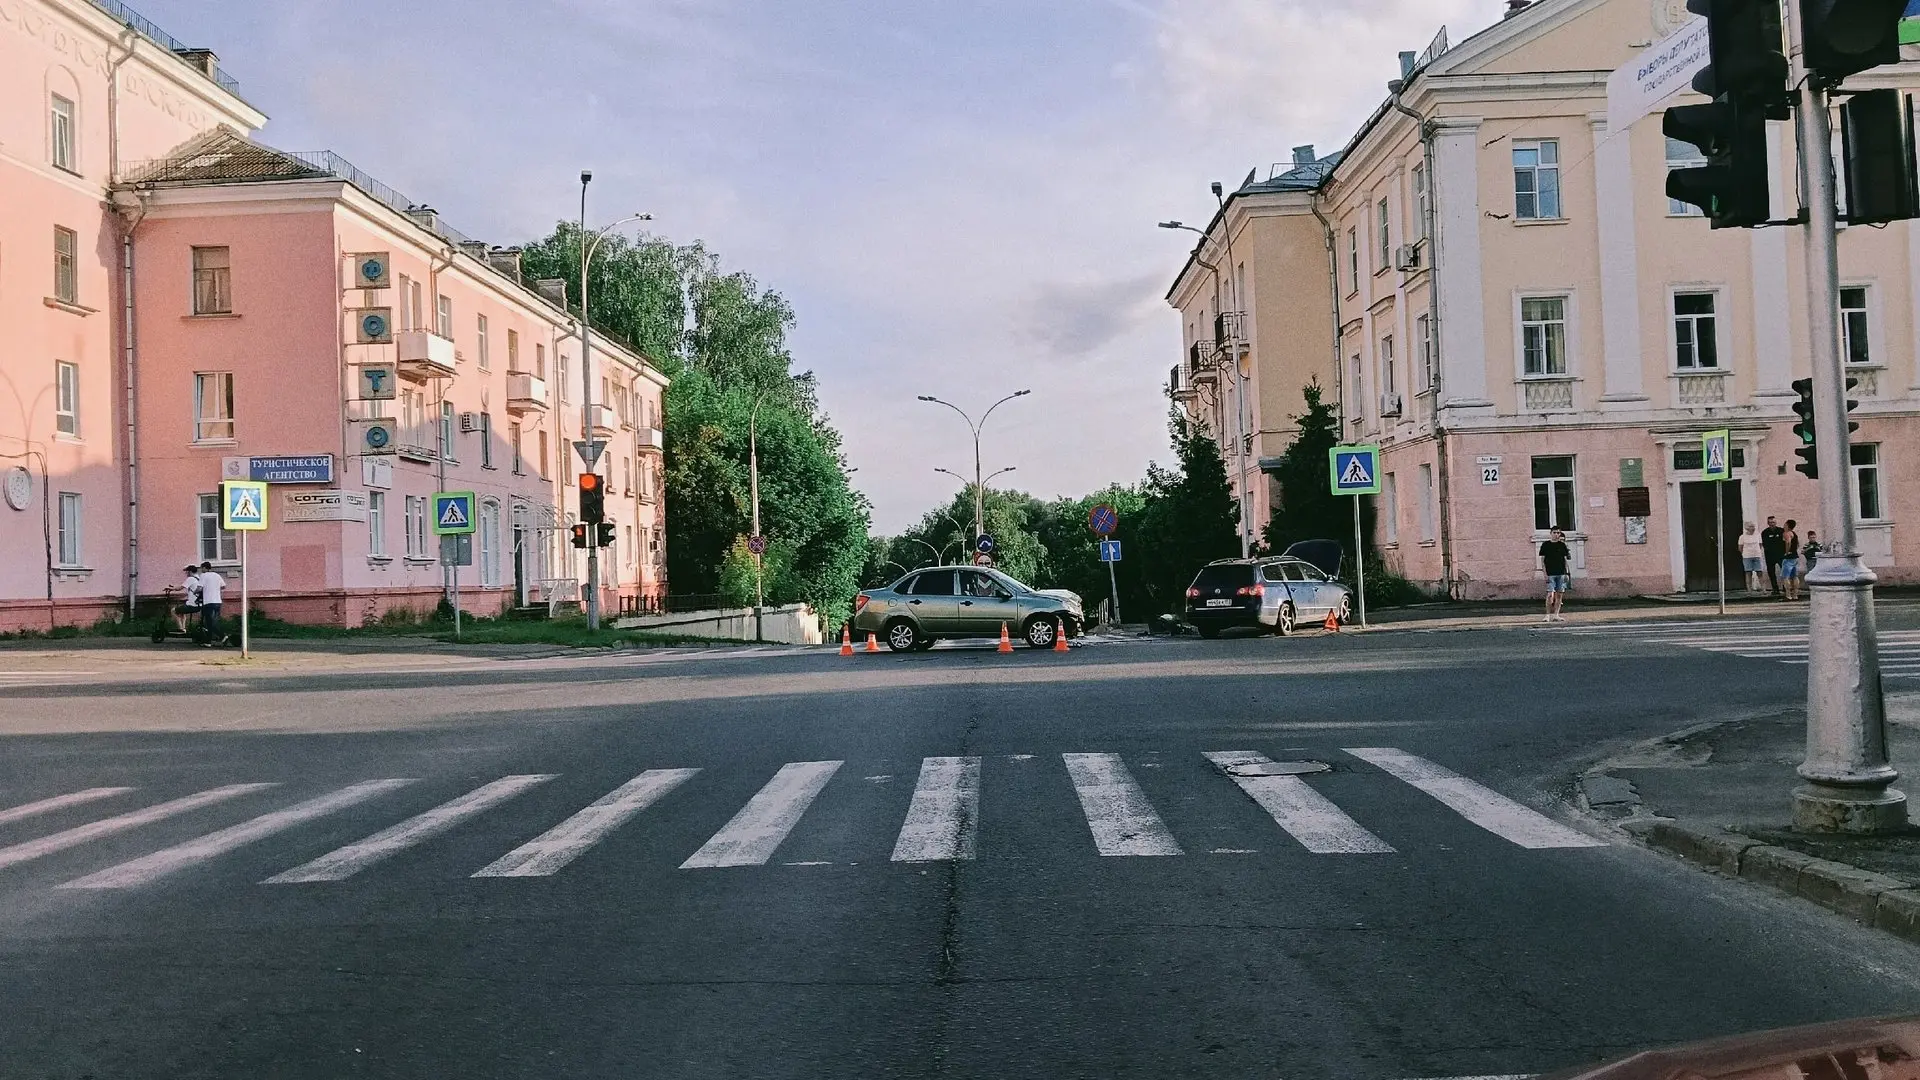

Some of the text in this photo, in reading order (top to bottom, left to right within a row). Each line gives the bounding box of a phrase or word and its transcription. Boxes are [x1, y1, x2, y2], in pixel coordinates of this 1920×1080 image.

[1637, 52, 1669, 81] ВЫБОРЫ
[362, 259, 388, 448] ФОТО
[251, 458, 329, 468] ТУРИСТИЧЕСКОЕ
[263, 470, 317, 480] АГЕНТСТВО
[1484, 468, 1498, 481] 22
